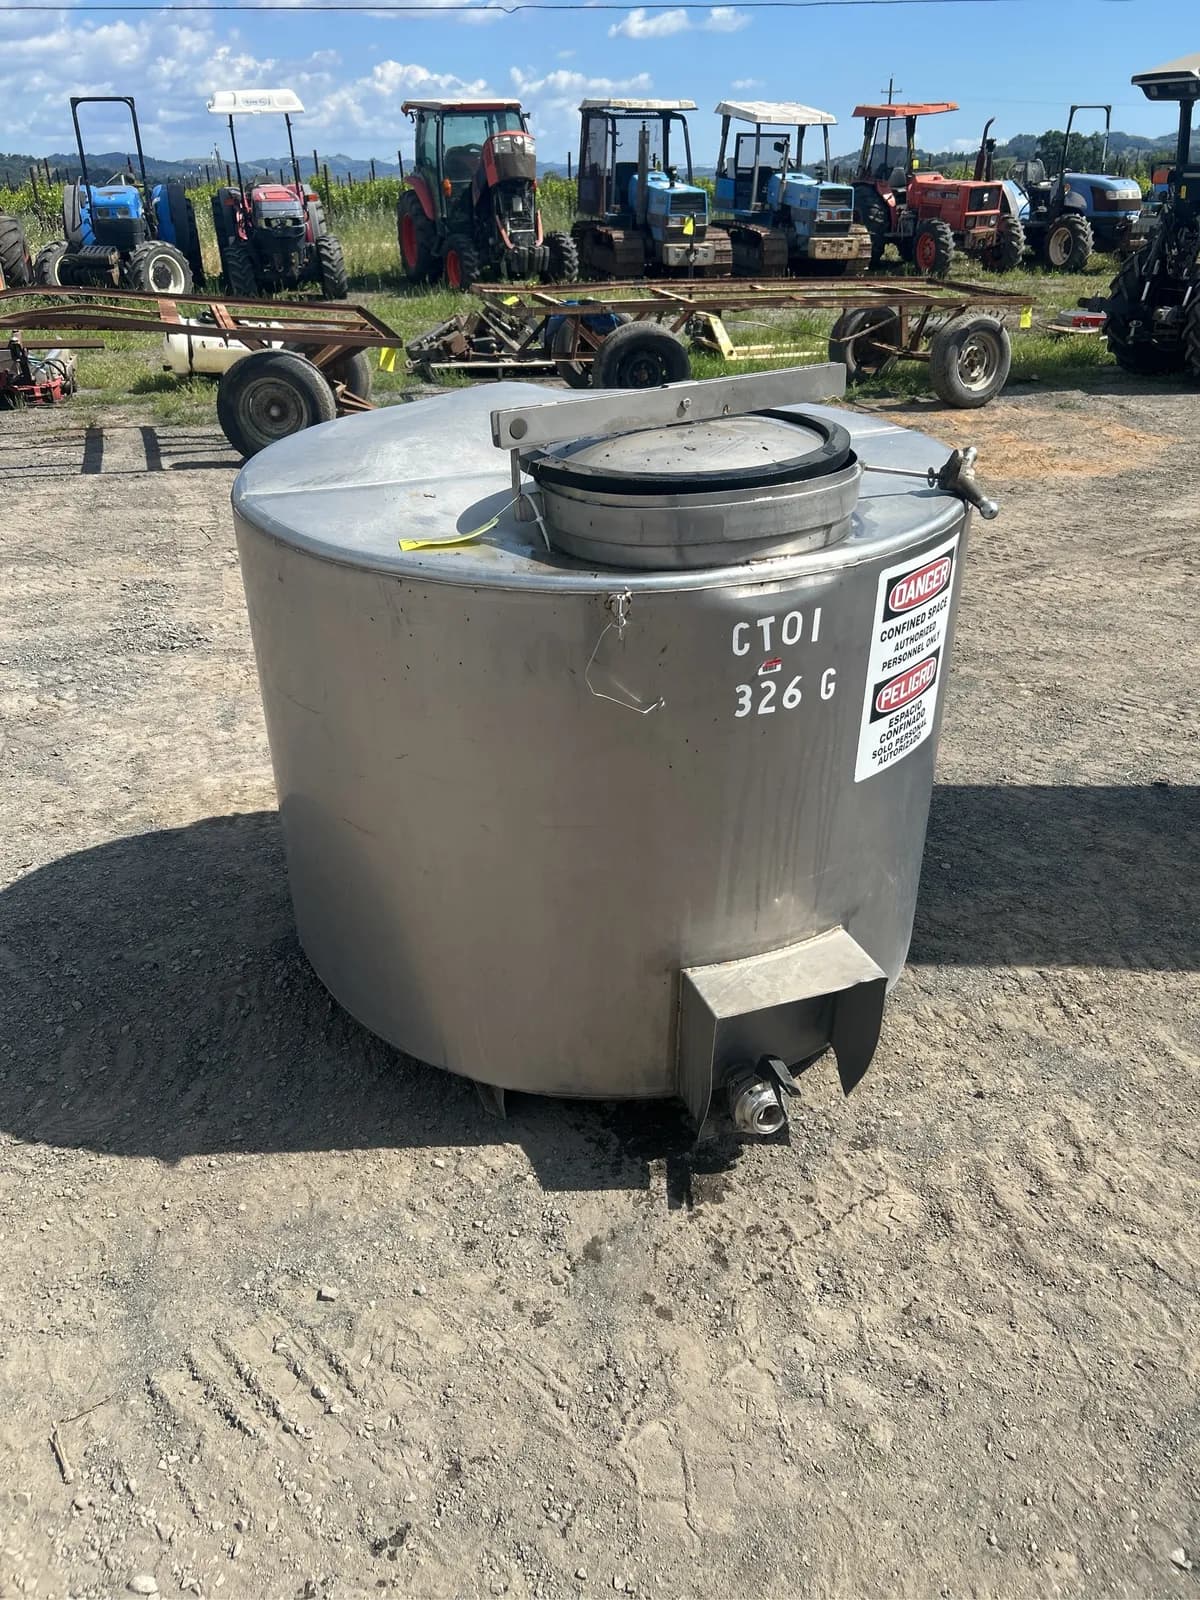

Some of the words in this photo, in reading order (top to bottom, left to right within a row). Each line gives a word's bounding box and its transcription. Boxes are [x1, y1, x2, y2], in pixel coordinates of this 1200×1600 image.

[894, 564, 948, 606] DANGER
[880, 612, 926, 642] CONFINED
[928, 596, 948, 620] SPACE
[894, 620, 936, 652] AUTHORIZED
[882, 643, 924, 672] PERSONNEL
[926, 630, 940, 650] ONLY
[734, 675, 802, 718] 326
[820, 668, 836, 700] G
[881, 663, 934, 708] PELIGRO
[880, 708, 926, 744] CONFINADO
[888, 700, 922, 728] ESPACIO
[872, 743, 893, 760] SOLO
[895, 719, 926, 746] PERSONAL
[878, 731, 922, 766] AUTORIZADO
